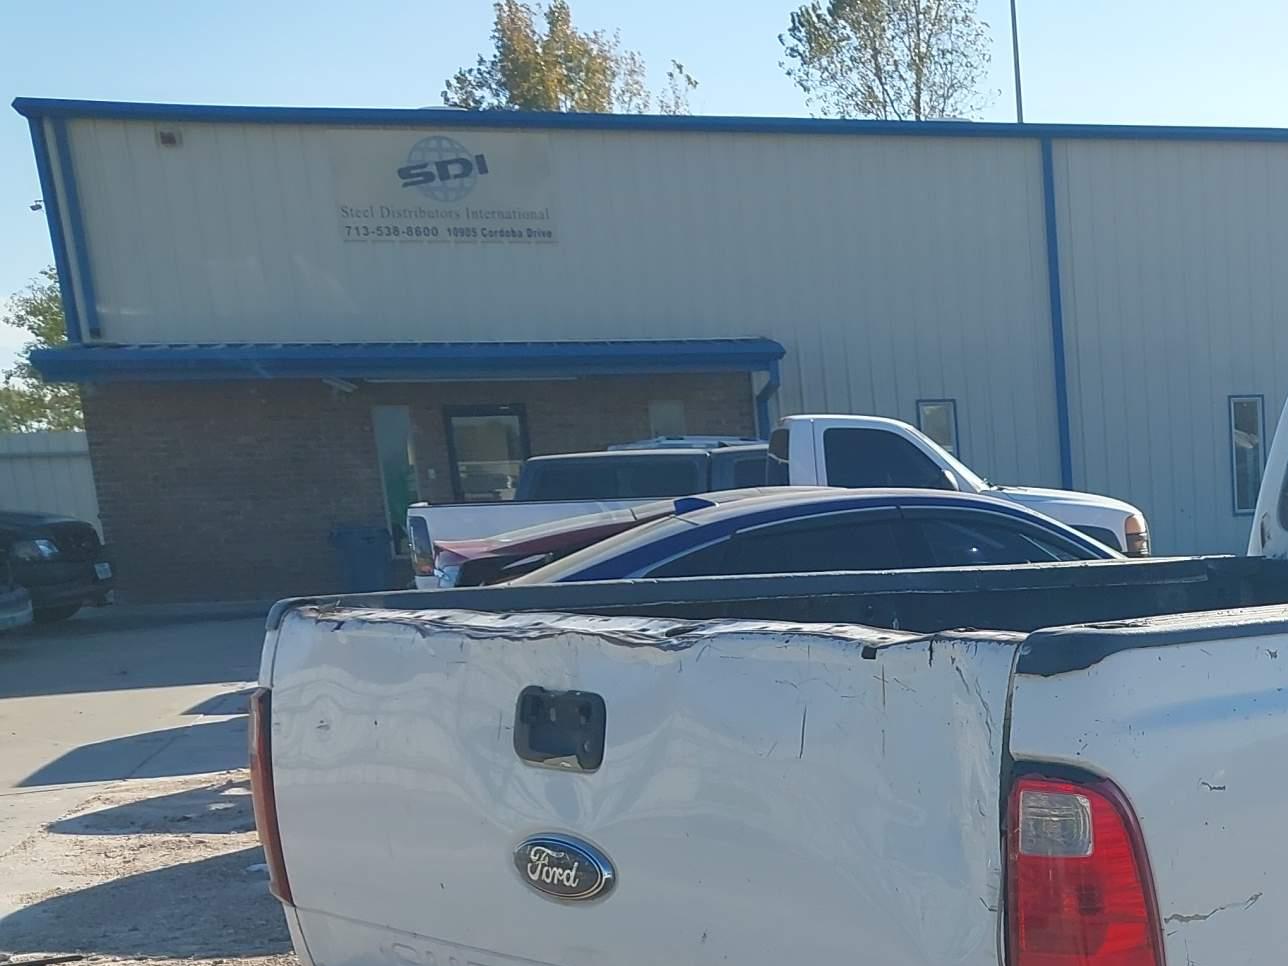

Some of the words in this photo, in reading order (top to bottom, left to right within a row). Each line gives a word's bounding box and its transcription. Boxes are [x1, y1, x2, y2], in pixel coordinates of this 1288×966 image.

[397, 153, 489, 188] SDI
[340, 205, 375, 219] Steel
[380, 206, 460, 220] Distributors
[465, 207, 550, 221] International
[527, 845, 579, 888] Ford
